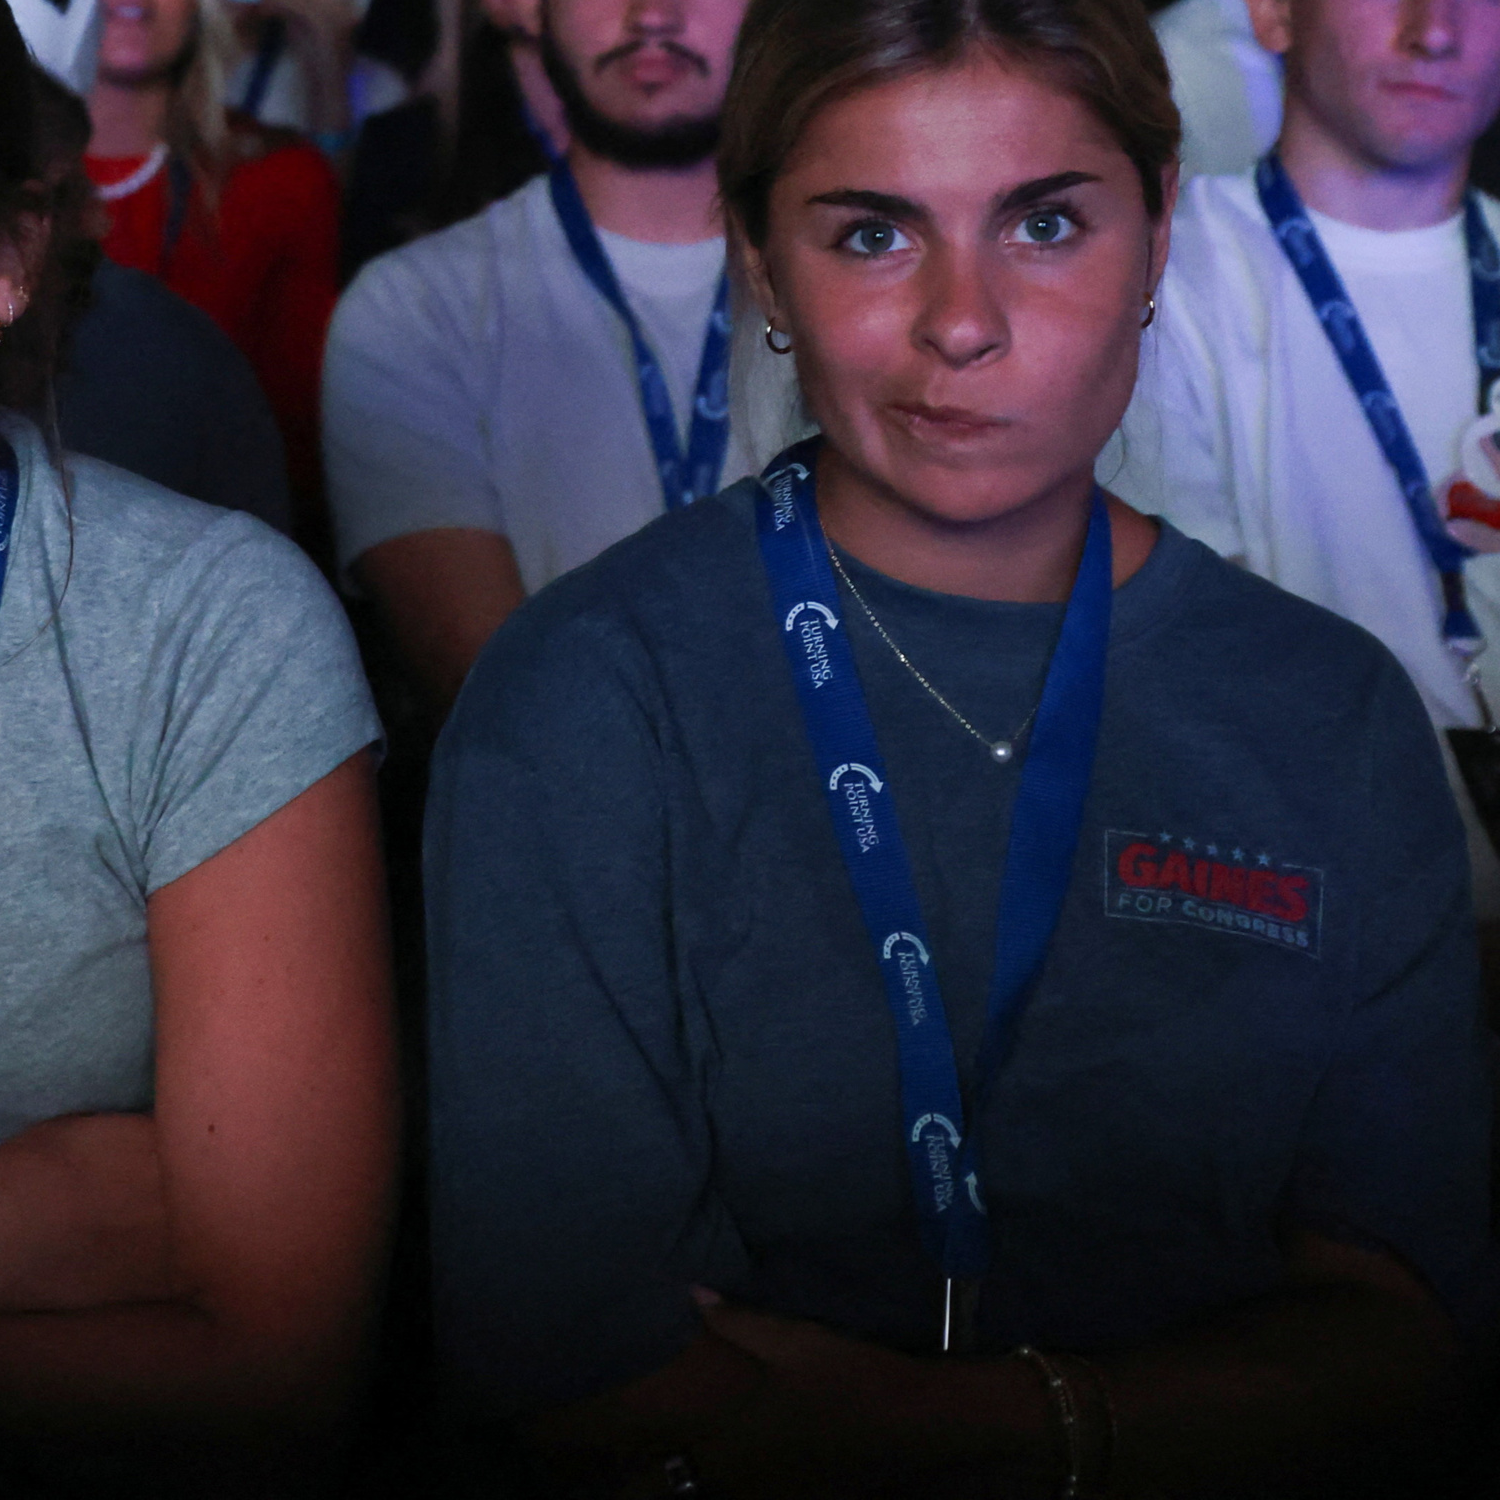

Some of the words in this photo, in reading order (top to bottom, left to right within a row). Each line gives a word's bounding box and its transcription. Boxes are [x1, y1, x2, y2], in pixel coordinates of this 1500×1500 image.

[800, 620, 819, 661] POINT
[810, 662, 823, 689] USA
[810, 618, 833, 681] TURNING
[844, 783, 863, 823] POINT
[856, 827, 870, 853] USA
[854, 781, 880, 846] TURNING
[1117, 843, 1308, 922] GAINES
[1118, 892, 1172, 913] FOR
[1182, 899, 1309, 948] CONGRESS
